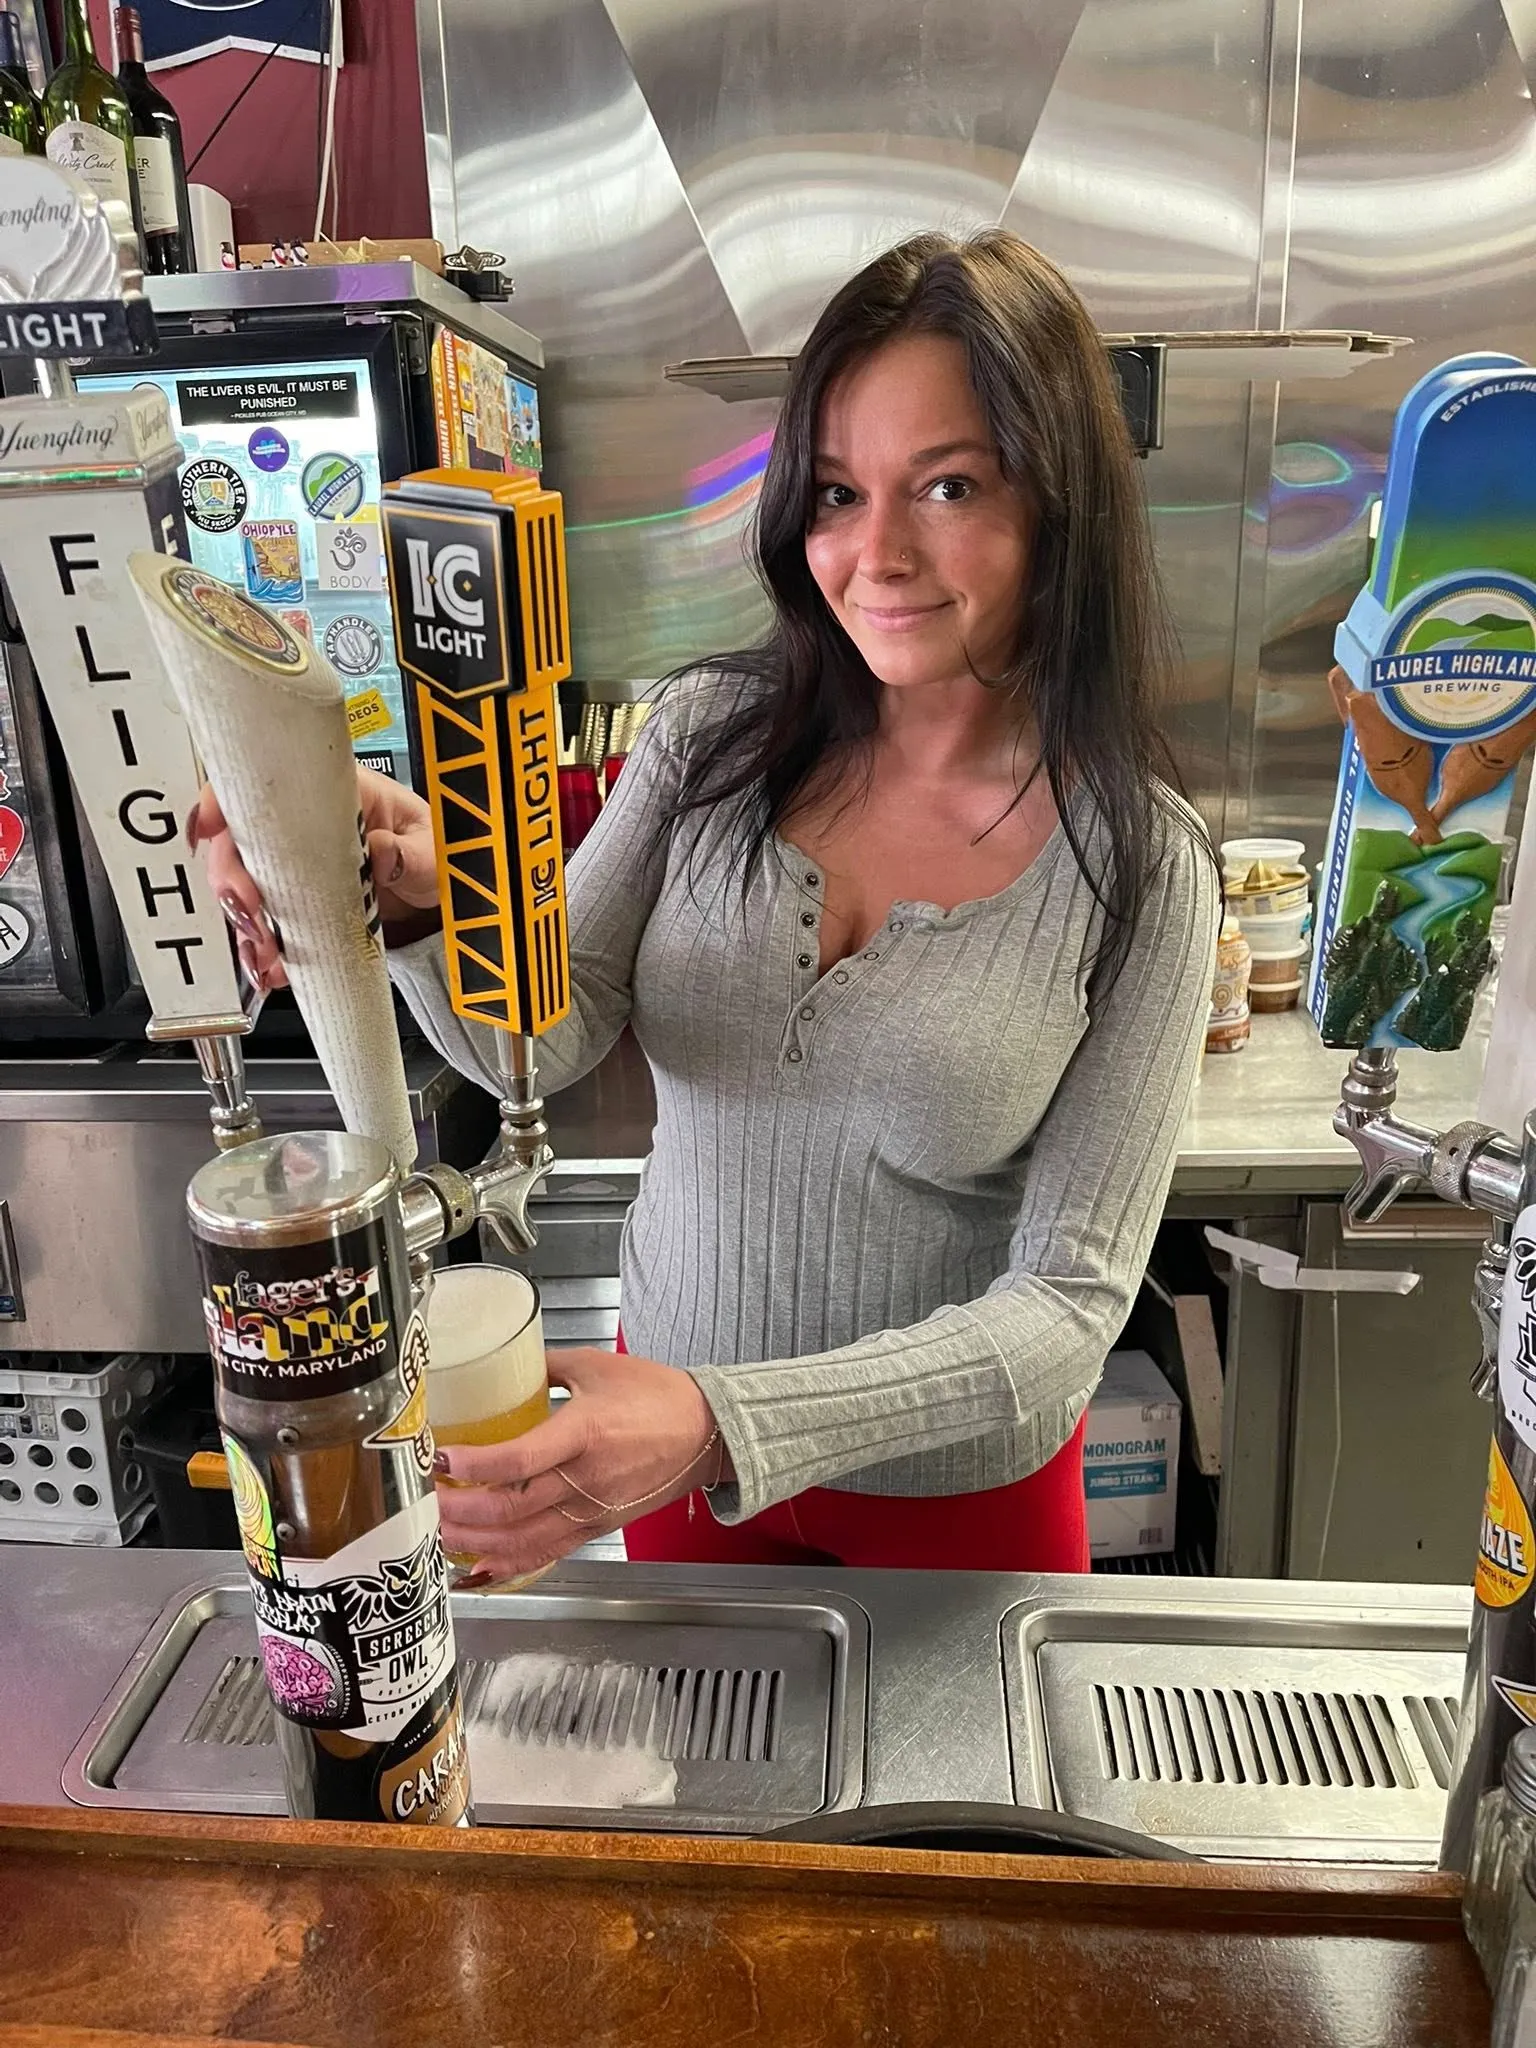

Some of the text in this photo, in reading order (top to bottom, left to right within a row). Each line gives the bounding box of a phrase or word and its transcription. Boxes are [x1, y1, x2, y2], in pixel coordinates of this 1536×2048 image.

[84, 153, 117, 171] Creek
[0, 197, 72, 233] engling
[186, 379, 348, 398] THE LIVER IS EVIL, IT MUST BE
[240, 397, 297, 409] PUNISHED
[1440, 381, 1536, 422] ESTABLISHE
[182, 461, 246, 507] SOUTHERN TIER
[242, 522, 296, 537] OHIOPYLE
[329, 575, 373, 590] BODY
[405, 538, 485, 627] IC
[325, 617, 378, 659] TAPHANDLES
[414, 622, 487, 660] LIGHT
[1375, 654, 1536, 681] LAUREL HIGHLAN
[1424, 682, 1501, 694] BREWING
[348, 703, 380, 723] DEOS
[49, 533, 204, 986] FLIGHT
[519, 708, 554, 851] LIGHT
[1328, 790, 1353, 919] HIGHLANDS
[278, 1338, 388, 1378] MARYLAND
[1083, 1438, 1166, 1458] MONOGRAM
[272, 1588, 337, 1614] BRAIN
[369, 1605, 438, 1658] SCREECH
[389, 1644, 429, 1684] OWL
